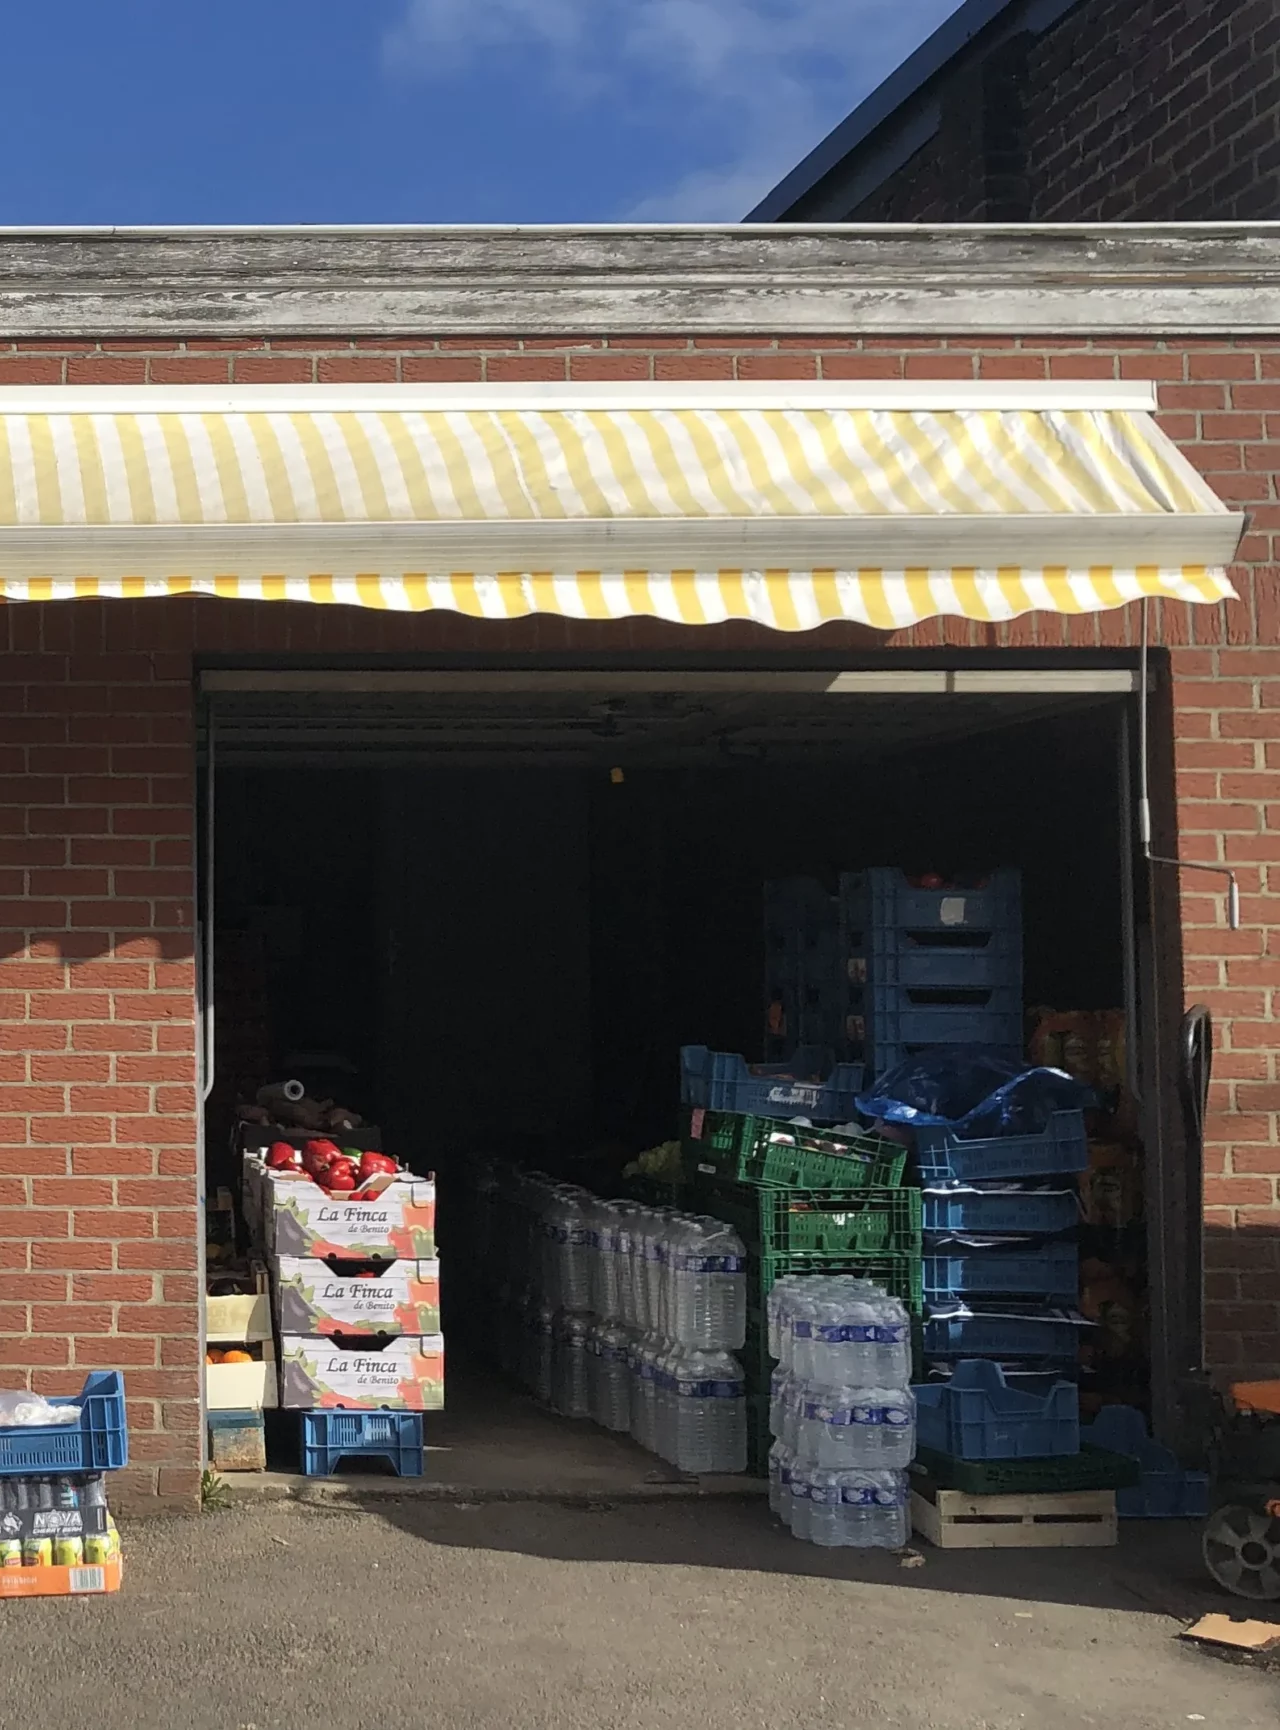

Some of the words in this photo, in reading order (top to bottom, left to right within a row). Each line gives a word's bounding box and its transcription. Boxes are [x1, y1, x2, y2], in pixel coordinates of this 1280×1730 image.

[317, 1207, 339, 1221] La
[344, 1207, 388, 1222] Finca
[348, 1223, 358, 1233] de
[359, 1224, 389, 1233] Benito
[322, 1283, 345, 1298] La
[349, 1283, 393, 1299] Finca
[353, 1300, 364, 1309] de
[365, 1301, 396, 1310] Benito
[326, 1357, 348, 1372] La
[353, 1357, 397, 1373] Finca
[357, 1374, 367, 1384] de
[369, 1375, 399, 1384] Benito
[33, 1509, 83, 1528] NOVA
[32, 1527, 61, 1535] CHERRY
